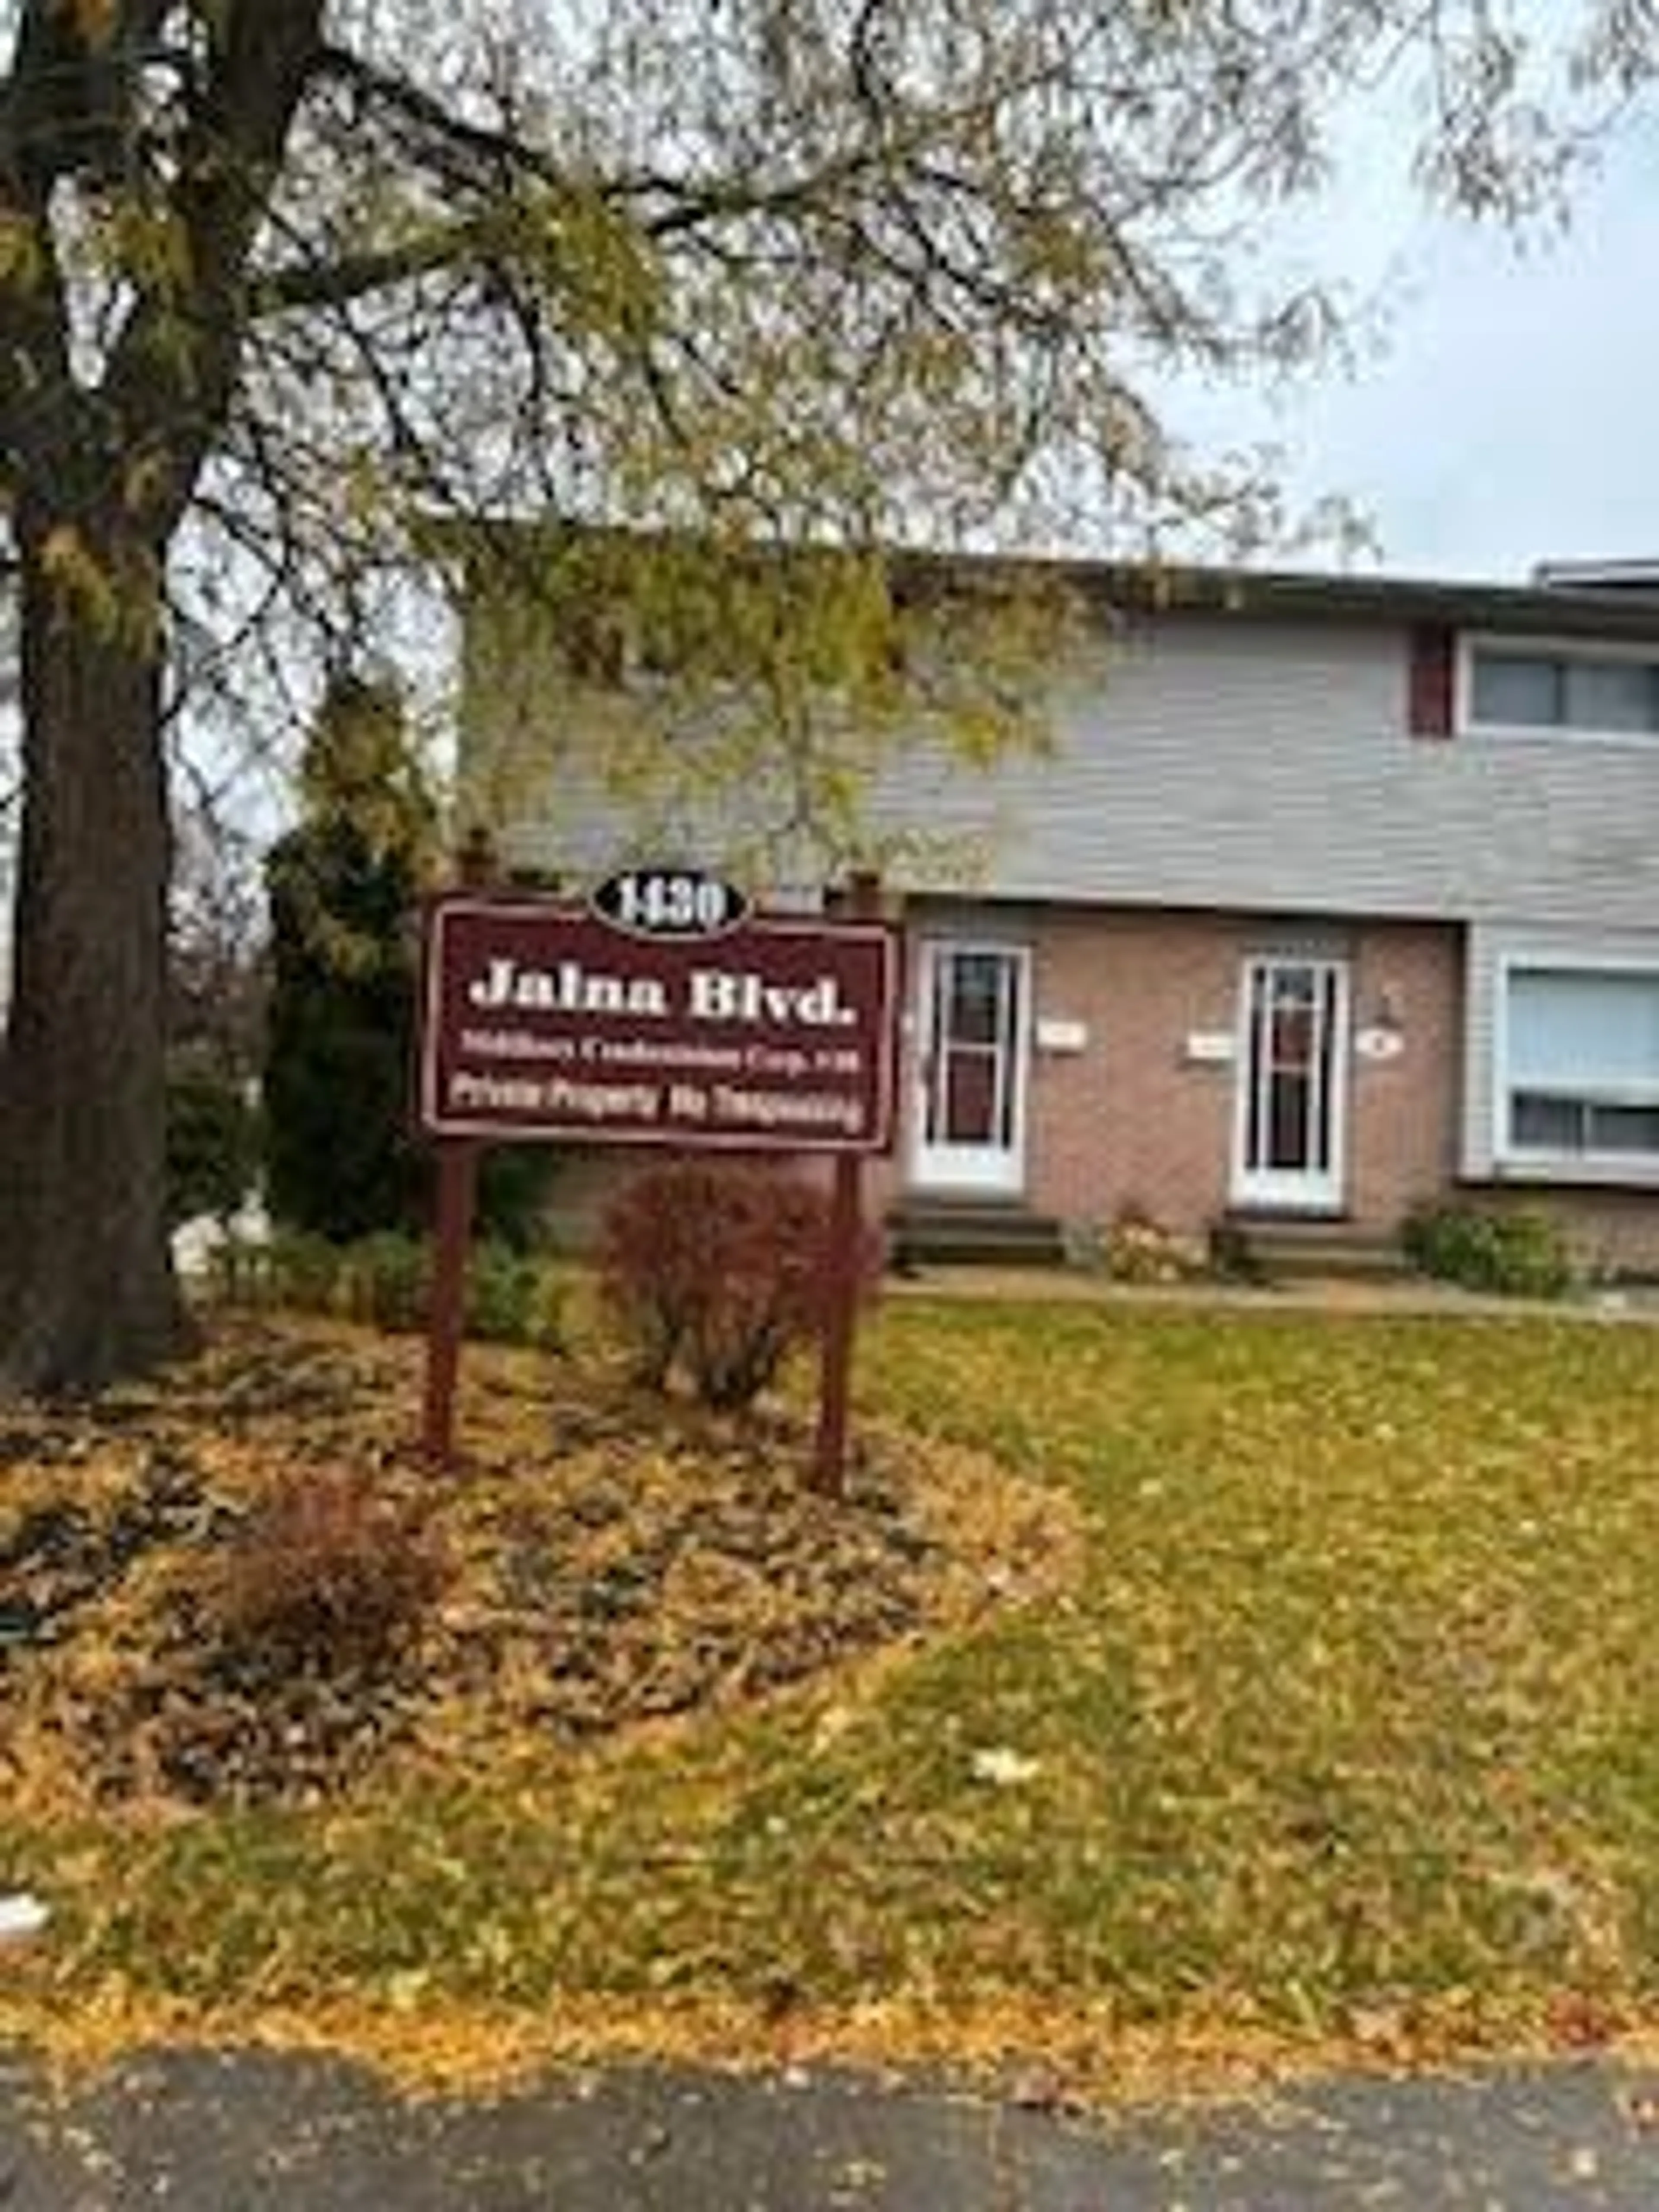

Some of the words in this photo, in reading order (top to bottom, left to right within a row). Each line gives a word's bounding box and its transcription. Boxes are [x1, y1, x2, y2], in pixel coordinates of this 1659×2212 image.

[619, 874, 728, 927] 1430
[468, 959, 667, 1017] Jalna
[690, 967, 858, 1025] Blvd.
